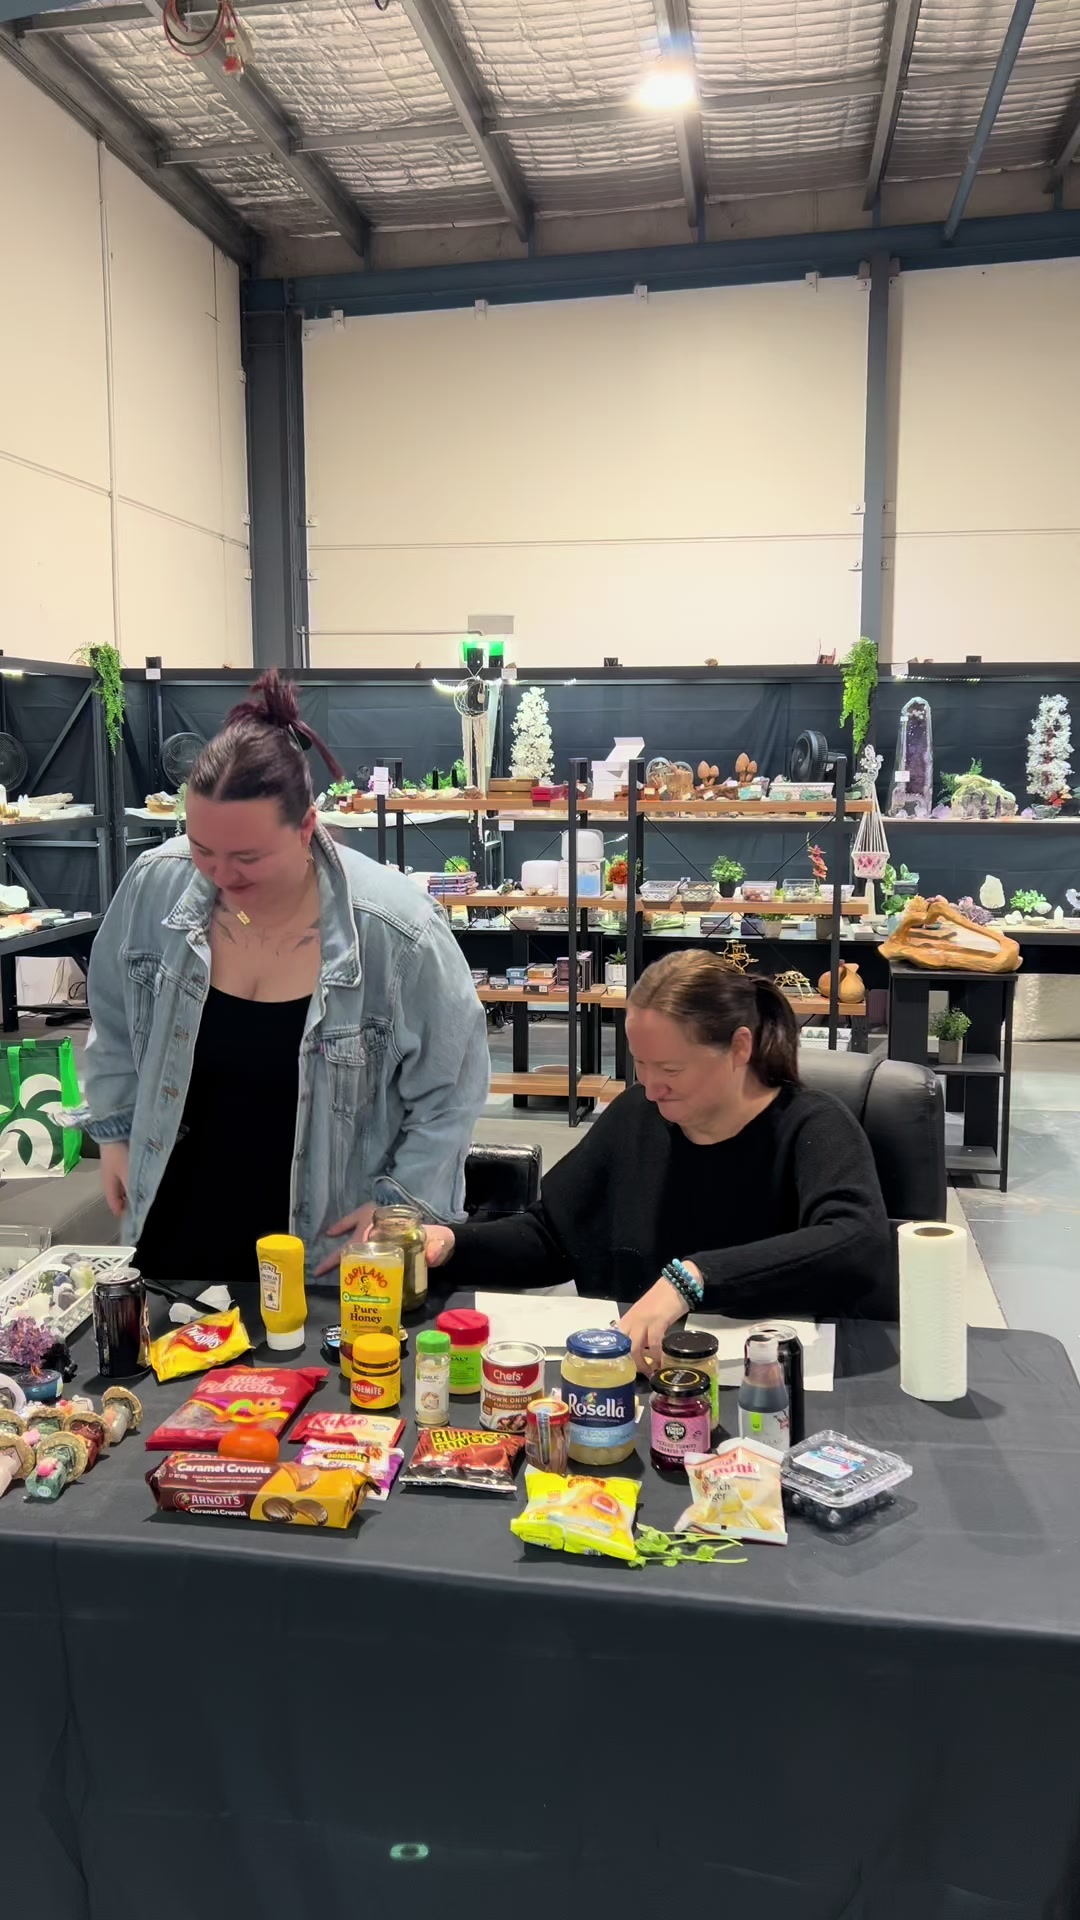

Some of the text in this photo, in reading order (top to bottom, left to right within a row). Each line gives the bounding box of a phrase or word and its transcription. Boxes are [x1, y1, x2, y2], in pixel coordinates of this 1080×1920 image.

[344, 1265, 388, 1288] CAPILANO
[353, 1304, 379, 1314] Pure
[350, 1312, 382, 1324] Honey
[509, 1395, 532, 1404] ONION
[568, 1392, 625, 1418] Rosella
[177, 1462, 271, 1474] Caramel Crowns
[191, 1493, 241, 1505] ARNOTT'S
[189, 1507, 220, 1516] Caramel
